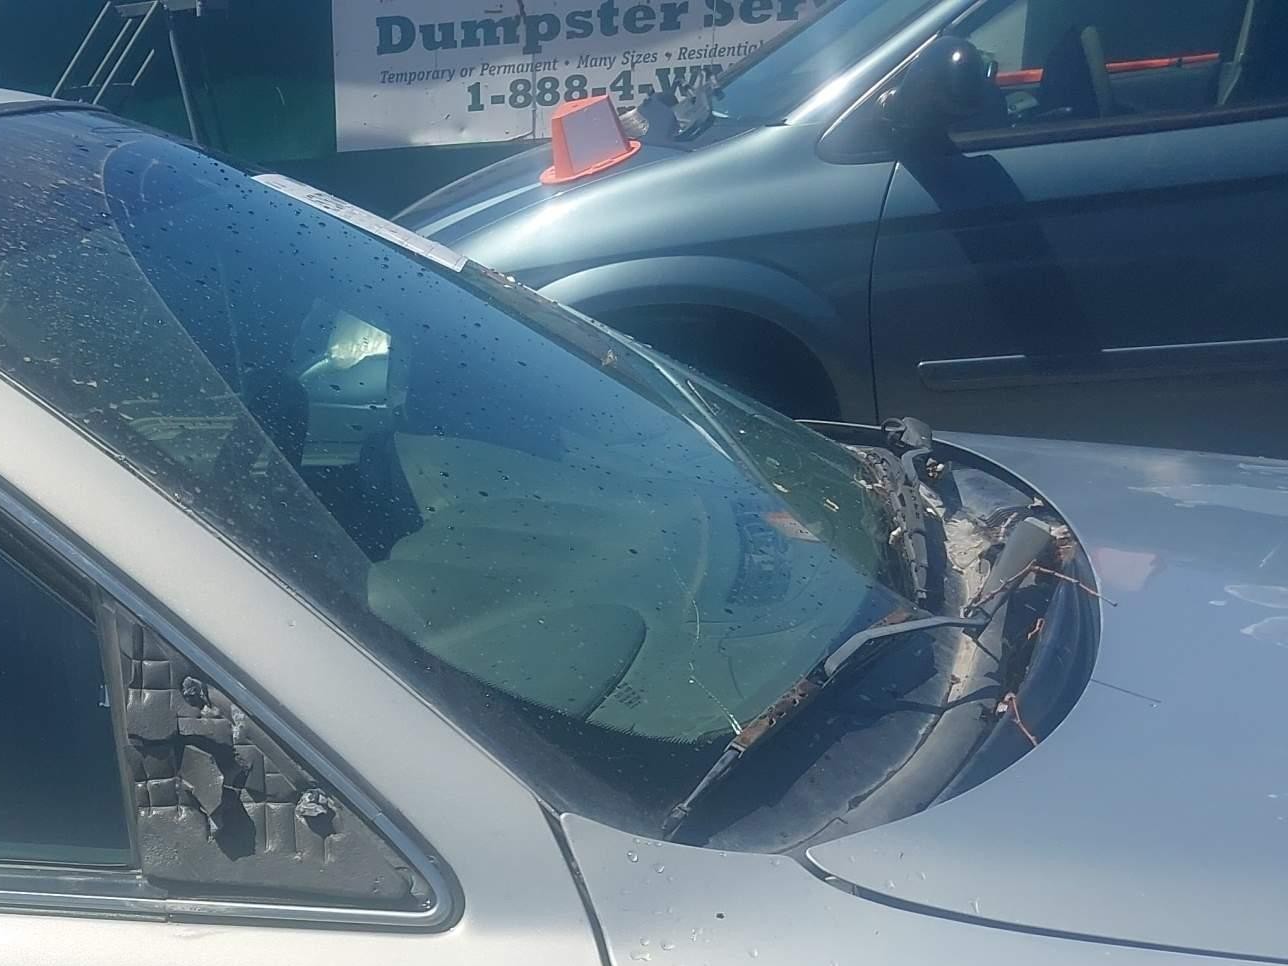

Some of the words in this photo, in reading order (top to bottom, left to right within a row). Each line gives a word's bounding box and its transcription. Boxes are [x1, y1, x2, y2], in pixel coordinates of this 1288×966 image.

[376, 0, 688, 56] Dumpster
[380, 67, 456, 86] Temporary
[460, 65, 475, 78] or
[480, 58, 560, 77] Permanent
[576, 52, 616, 70] Many
[621, 50, 659, 66] Sizes
